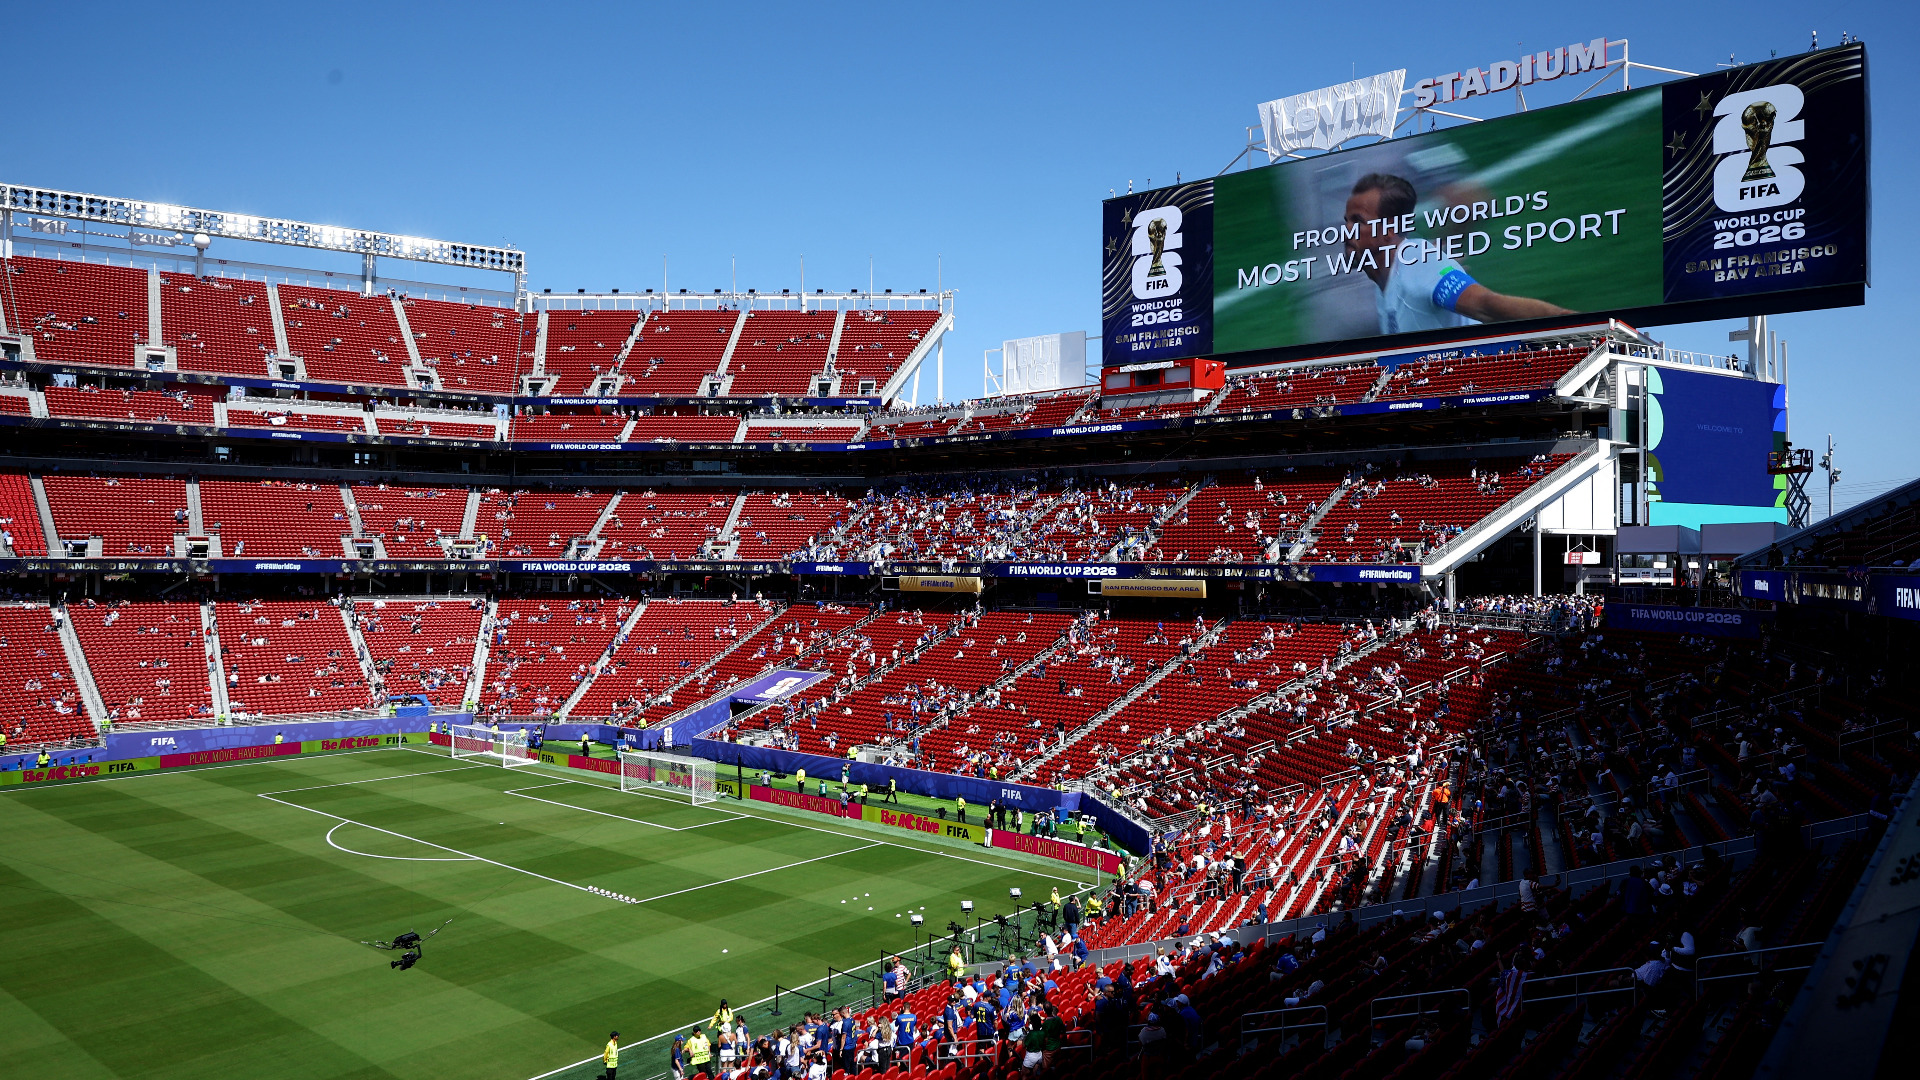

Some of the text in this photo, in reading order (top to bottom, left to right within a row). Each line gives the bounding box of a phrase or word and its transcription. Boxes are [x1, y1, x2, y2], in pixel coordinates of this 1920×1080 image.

[1413, 38, 1606, 109] STADIUM
[1740, 183, 1780, 200] FIFA
[1292, 190, 1548, 250] FROM THE WORLD'S
[1713, 208, 1806, 230] WORLD CUP
[1713, 222, 1806, 250] 2026
[1237, 208, 1627, 290] MOST WATCHED SPORT
[1685, 244, 1838, 273] SAN FRANCISCO
[1714, 261, 1806, 282] BAY AREA
[1146, 279, 1169, 290] FIFA
[1132, 298, 1182, 312] WORLD CUP
[1131, 309, 1182, 327] 2026
[1115, 325, 1200, 344] SAN FRANCISCO
[1131, 337, 1182, 351] BAY AREA
[1697, 424, 1732, 432] WELCOME
[27, 562, 50, 570] SAN
[52, 562, 116, 570] FRANCISCO
[256, 563, 301, 571] #FIFAWorldCup
[522, 563, 631, 571] FIFA WORLD CUP 2026
[1009, 566, 1117, 576] FIFA WORLD CUP 2026
[1150, 568, 1271, 577] SAN FRANCISCO BAY AREA
[1359, 570, 1412, 580] #FIFAWorldCup
[1896, 587, 1914, 608] FIFA
[1631, 609, 1742, 624] FIFA WORLD CUP 2026
[151, 737, 176, 746] FIFA
[386, 736, 408, 745] FIFA
[624, 733, 636, 742] FIFA
[321, 740, 338, 750] Be
[189, 745, 277, 764] PLAY. MOVE. HAVE FUN!
[541, 753, 555, 764] FIFA
[109, 762, 135, 773] FIFA
[23, 770, 45, 782] Be
[717, 783, 734, 794] FIFA
[1001, 788, 1023, 801] FIFA
[881, 809, 896, 825] Be
[946, 825, 970, 839] FIFA
[1015, 835, 1105, 868] PLAY. MOVE. HAVE FUN!
[976, 1010, 986, 1023] 11
[905, 1021, 911, 1034] 4
